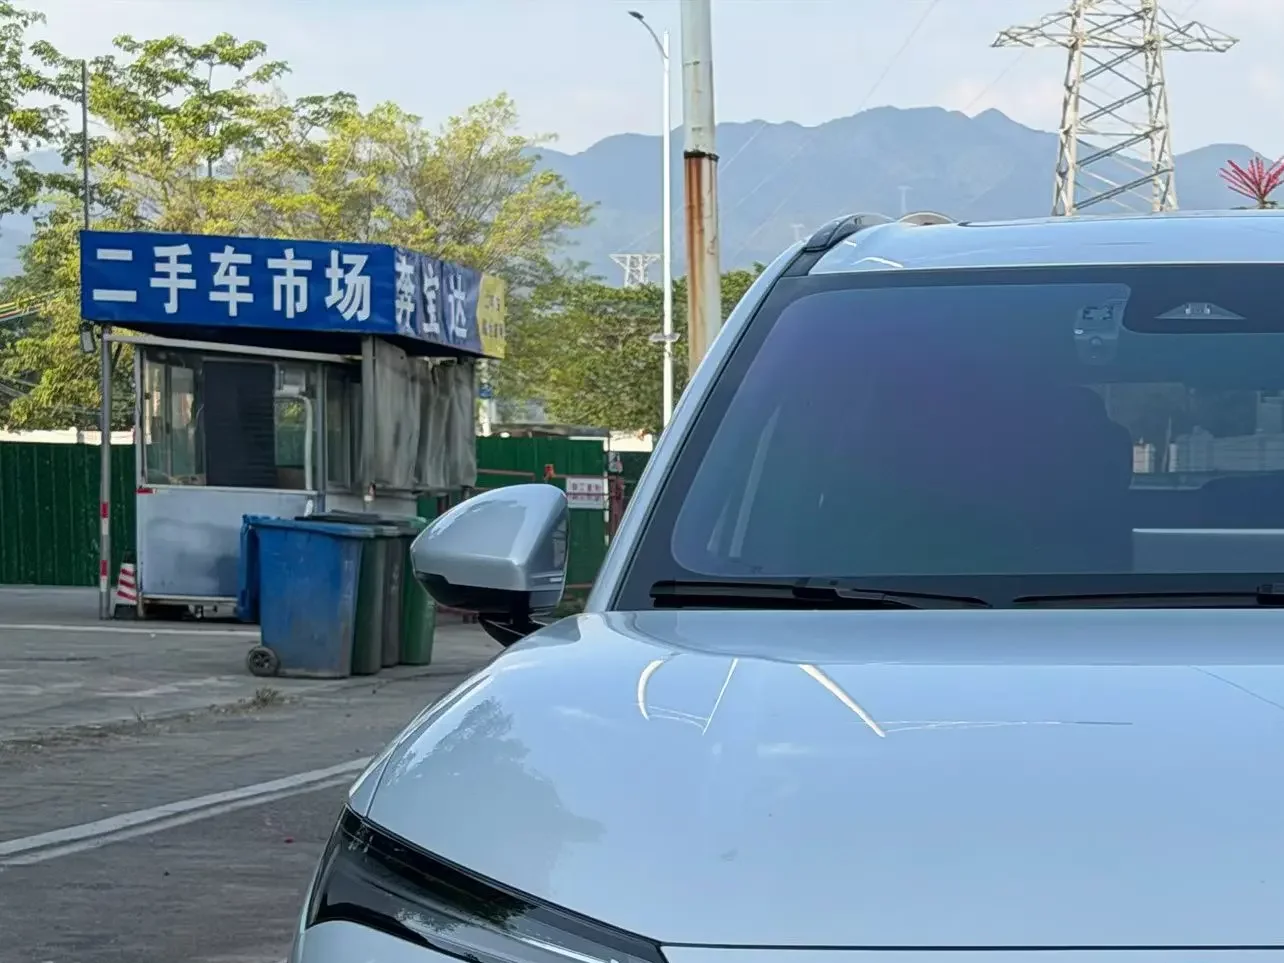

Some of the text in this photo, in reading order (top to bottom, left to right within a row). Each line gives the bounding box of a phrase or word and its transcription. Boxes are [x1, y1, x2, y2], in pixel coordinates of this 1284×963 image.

[93, 244, 372, 322] 二手车市场
